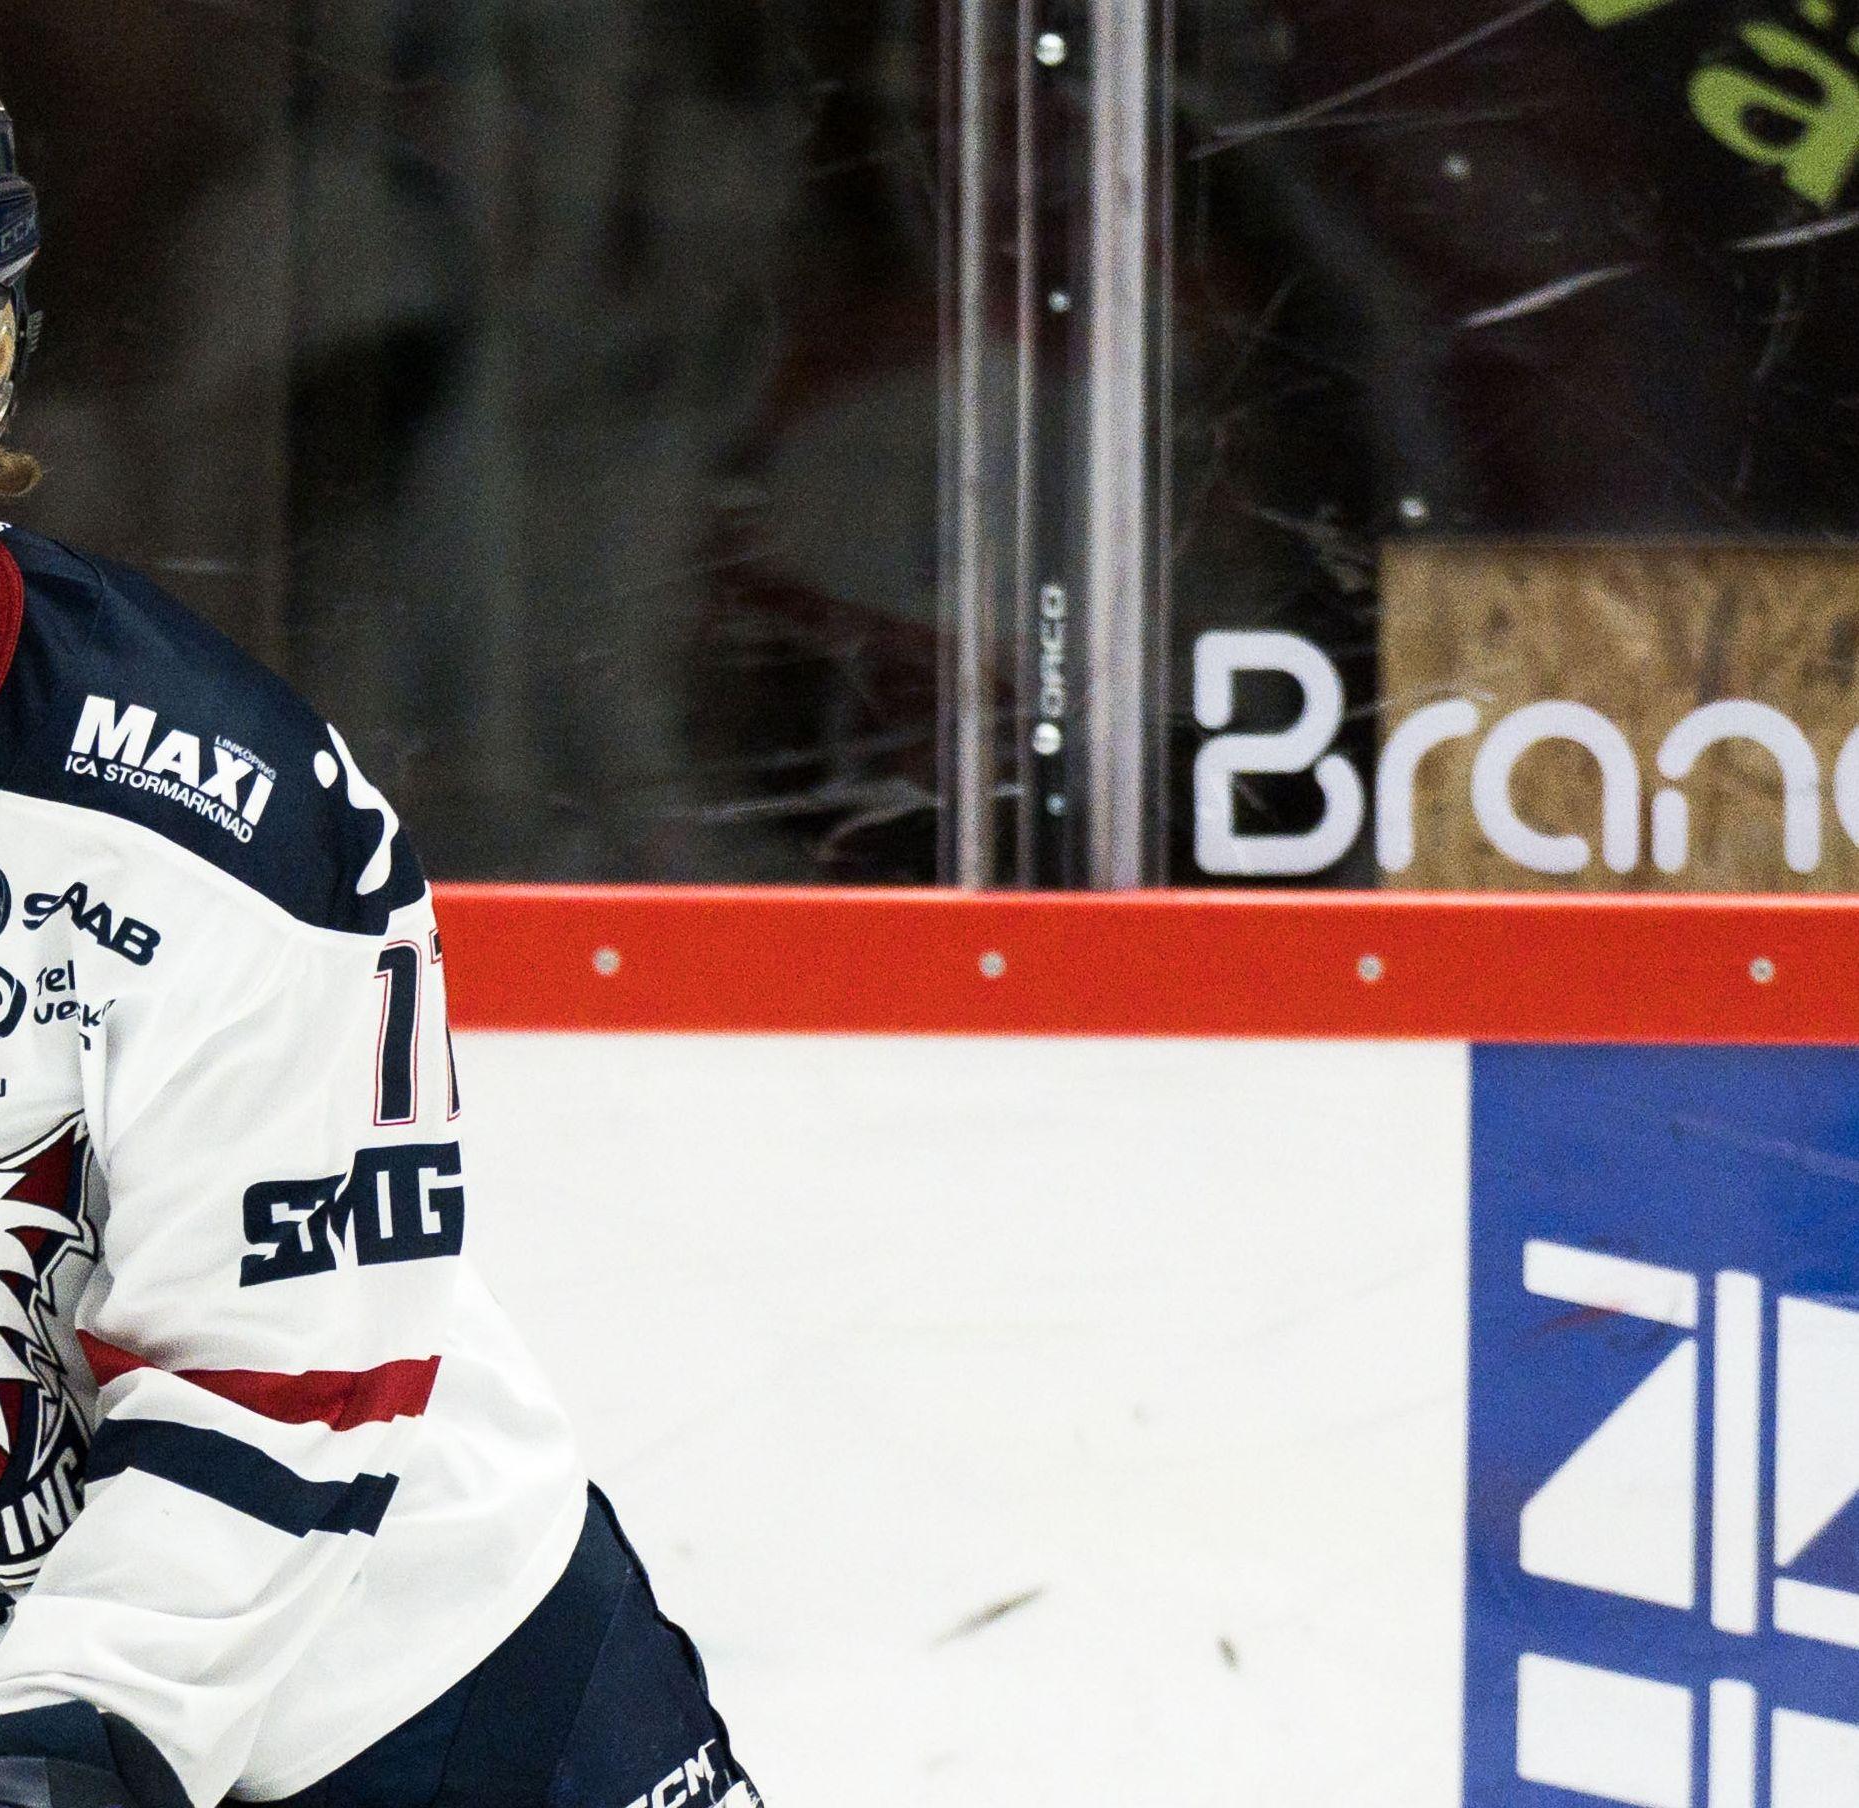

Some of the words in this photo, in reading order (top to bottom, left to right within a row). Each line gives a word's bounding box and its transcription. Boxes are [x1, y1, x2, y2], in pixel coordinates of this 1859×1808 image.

[64, 754, 98, 778] ICA
[103, 765, 254, 844] STORMARKNAD
[70, 694, 275, 826] MAXI
[1192, 629, 1859, 876] Bran
[22, 881, 161, 966] SAAB
